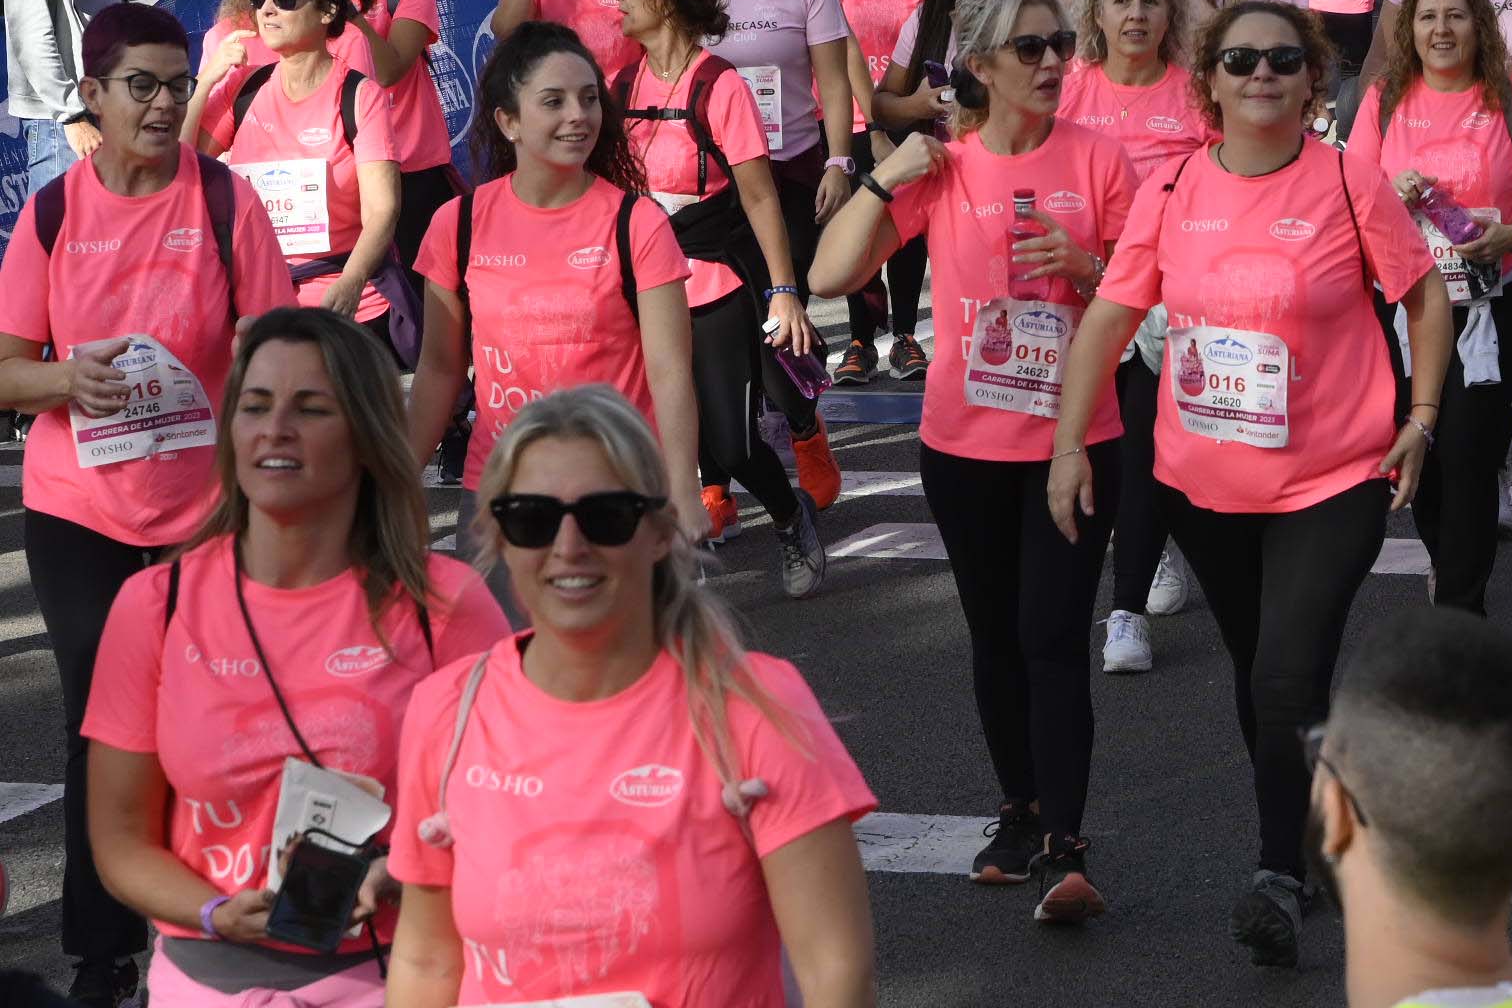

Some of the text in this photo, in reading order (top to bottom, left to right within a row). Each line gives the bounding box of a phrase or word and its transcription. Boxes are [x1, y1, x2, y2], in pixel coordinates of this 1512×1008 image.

[265, 199, 293, 212] 016
[960, 201, 1003, 218] OSHO
[1181, 218, 1228, 232] OYSHO
[66, 238, 121, 255] OYSHO
[1019, 318, 1063, 334] ASTURIANA
[482, 346, 513, 374] TU
[1016, 345, 1057, 364] 016
[1209, 346, 1248, 361] ASTURIANA
[1016, 365, 1050, 378] 24623
[982, 374, 1015, 386] CARRERA
[1209, 374, 1245, 393] 016
[132, 379, 162, 399] 16
[976, 389, 1014, 402] OYSHO
[1212, 396, 1241, 407] 24620
[124, 403, 160, 418] 24746
[1188, 405, 1215, 415] CARRERA
[1236, 412, 1257, 421] MUJER
[91, 426, 129, 438] CARRERA
[130, 422, 142, 430] DE
[143, 419, 153, 428] LA
[155, 415, 181, 426] MUJER
[166, 429, 207, 440] Santander
[1246, 427, 1279, 439] Santander
[91, 441, 133, 457] OYSHO
[185, 644, 260, 677] OSHO
[186, 798, 242, 834] TU
